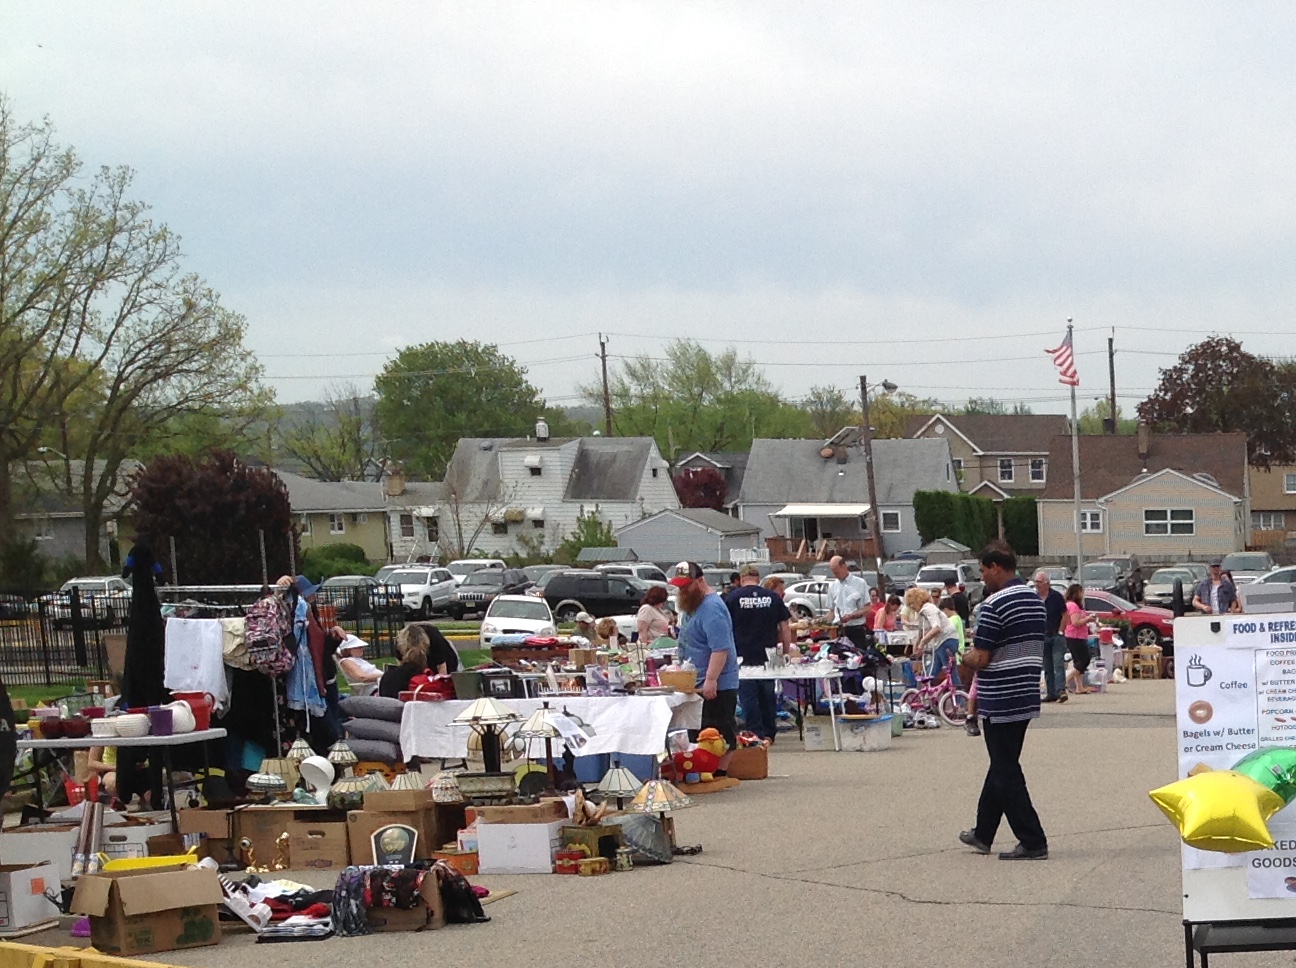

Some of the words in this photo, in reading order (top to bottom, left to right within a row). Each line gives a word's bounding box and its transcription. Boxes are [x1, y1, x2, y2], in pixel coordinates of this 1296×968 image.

[740, 596, 771, 604] CHICAGO
[1233, 623, 1256, 634] FOOD
[1259, 622, 1265, 632] &
[1219, 681, 1248, 690] Coffee
[1183, 729, 1211, 739] Bagels
[1213, 728, 1225, 737] w/
[1195, 744, 1223, 752] Cream
[1226, 742, 1256, 750] Cheese
